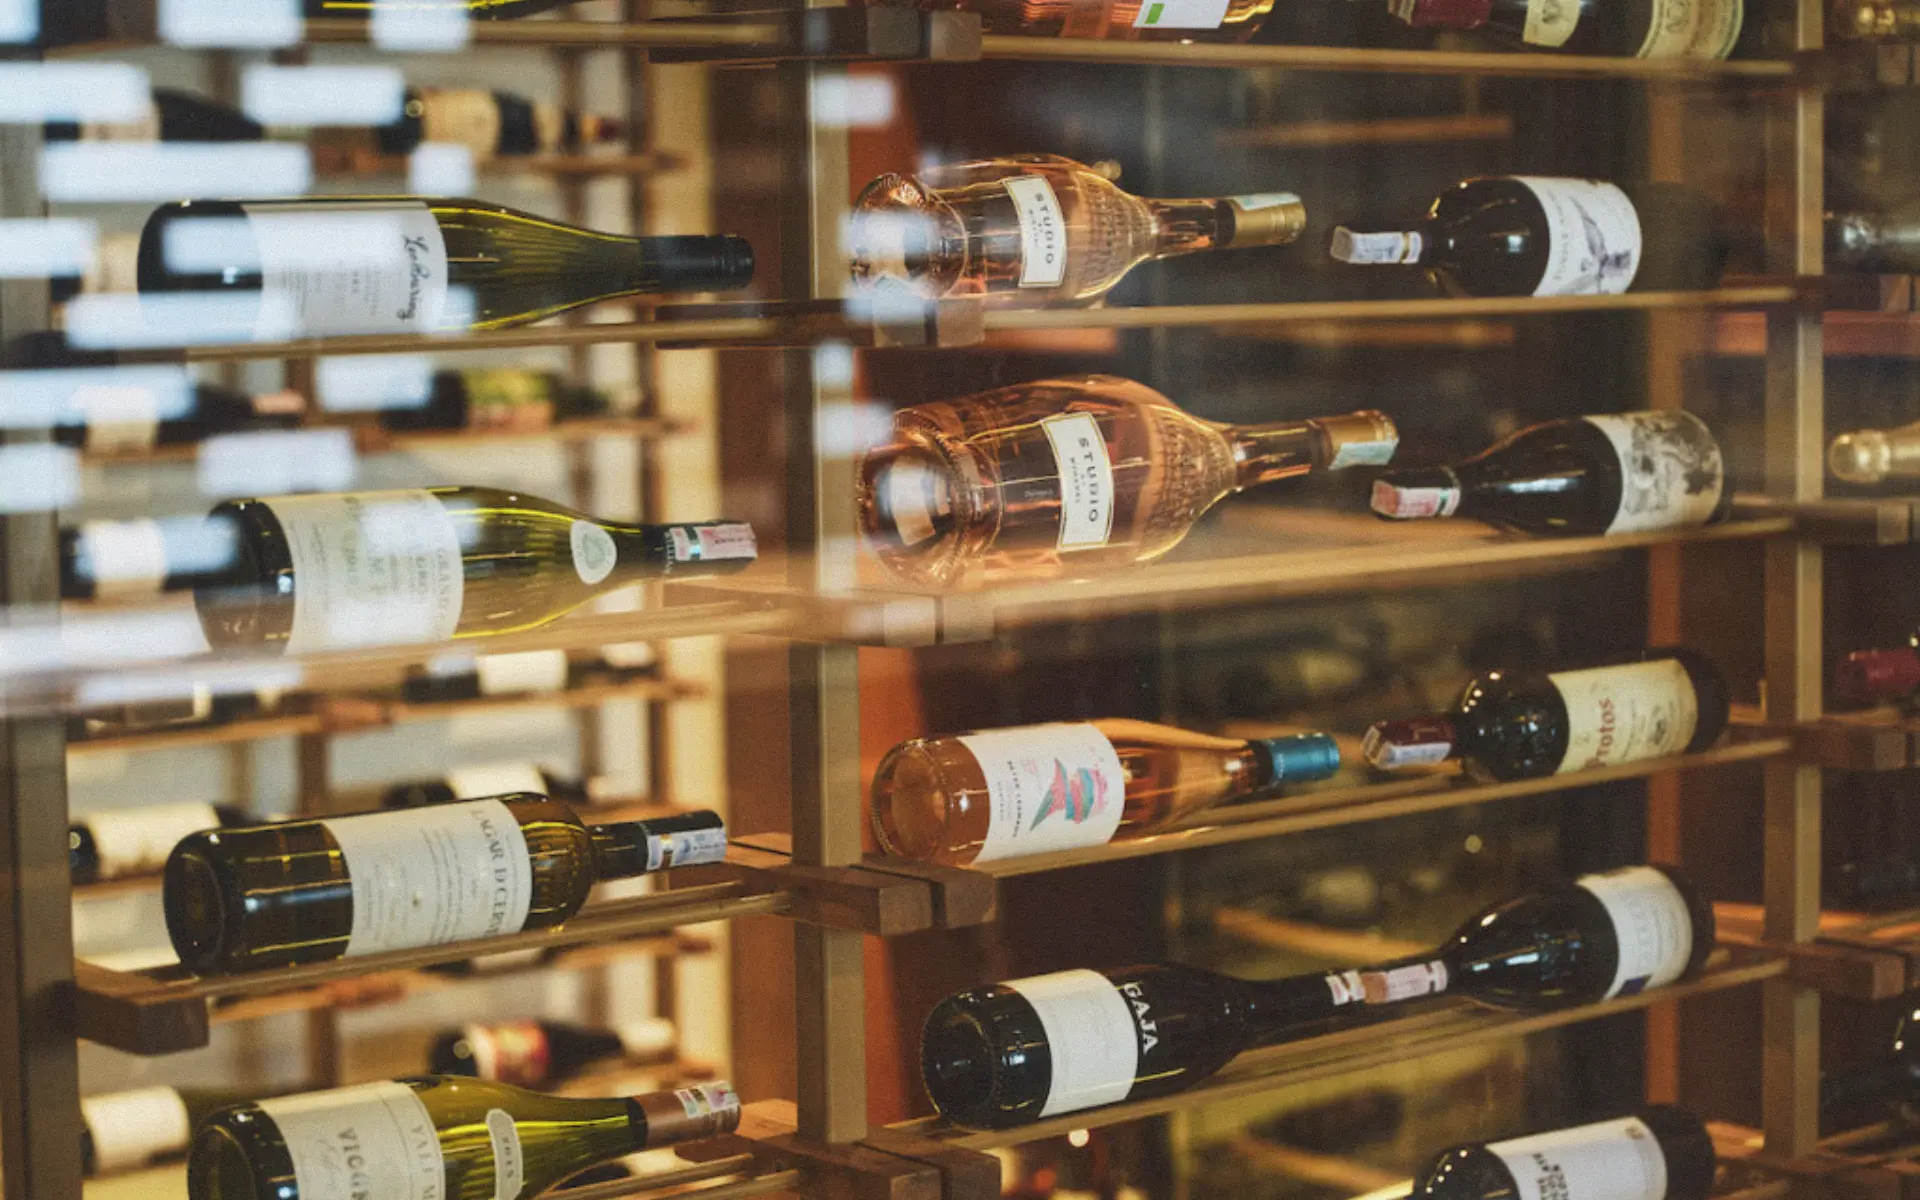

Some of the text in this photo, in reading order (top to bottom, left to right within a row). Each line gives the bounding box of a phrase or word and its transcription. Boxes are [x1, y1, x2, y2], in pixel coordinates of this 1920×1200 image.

[1034, 193, 1055, 264] STUDIO
[1078, 437, 1099, 522] STUDIO
[1124, 981, 1160, 1055] GAJA
